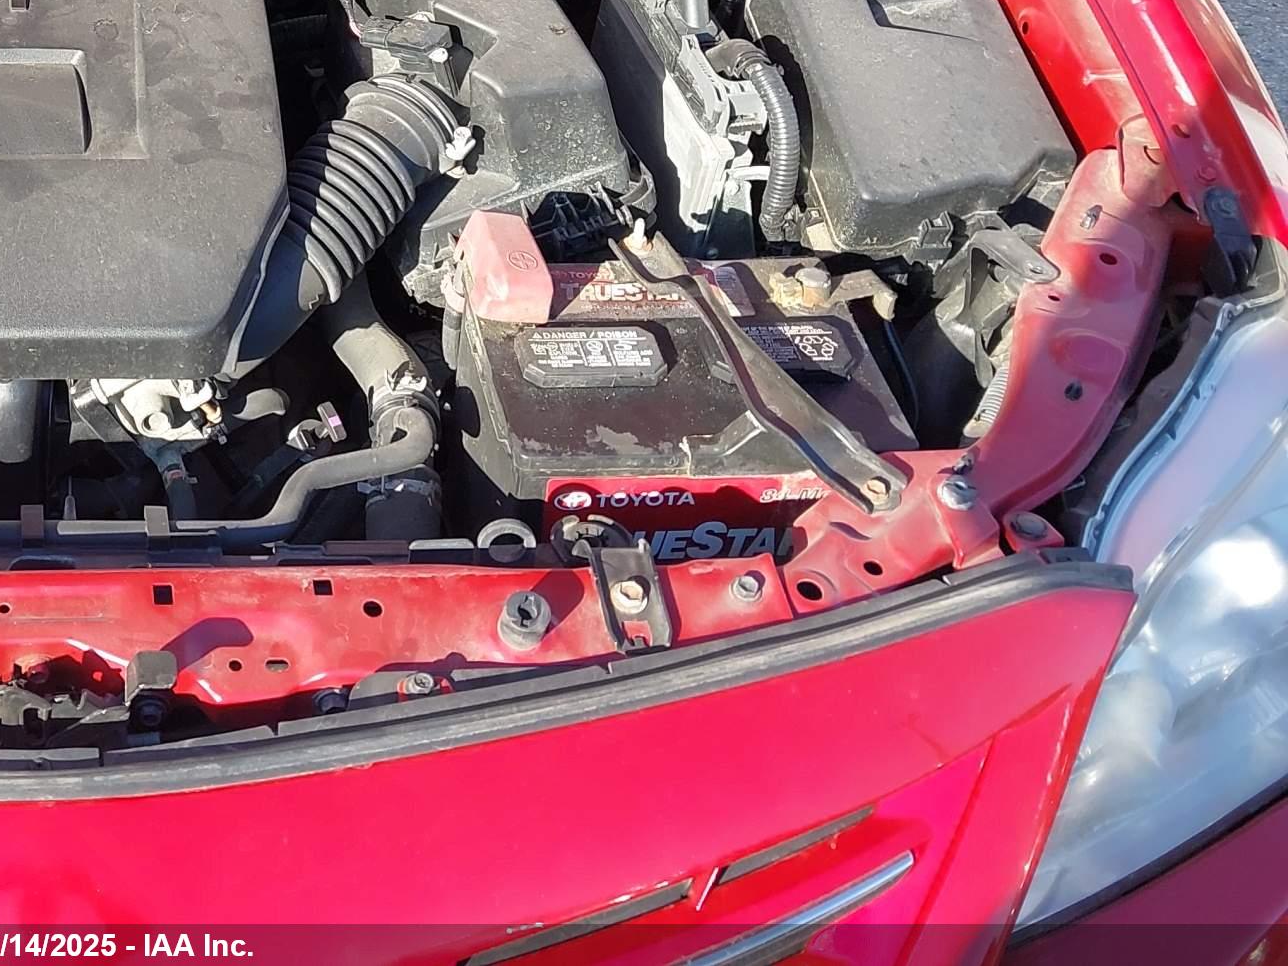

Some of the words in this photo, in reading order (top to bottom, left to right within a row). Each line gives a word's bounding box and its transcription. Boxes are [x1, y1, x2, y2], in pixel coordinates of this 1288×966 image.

[542, 331, 587, 339] DANGER
[597, 330, 638, 338] POISON
[596, 491, 695, 507] TOYOTA
